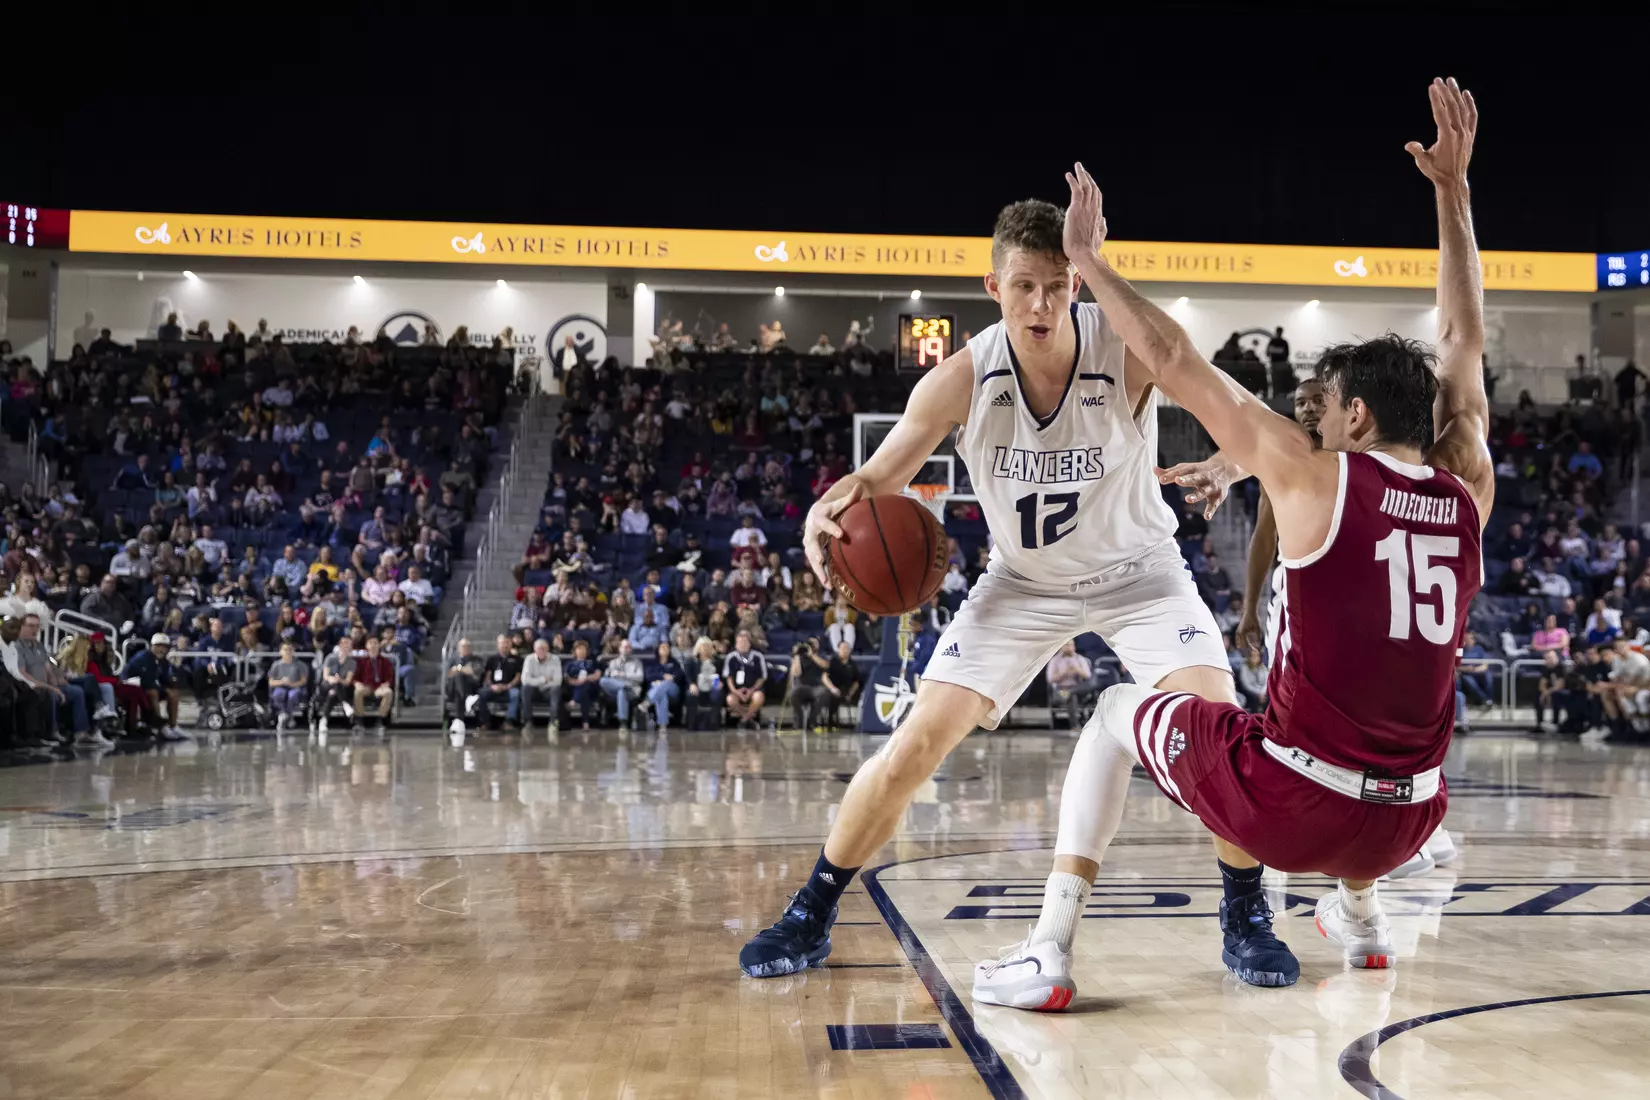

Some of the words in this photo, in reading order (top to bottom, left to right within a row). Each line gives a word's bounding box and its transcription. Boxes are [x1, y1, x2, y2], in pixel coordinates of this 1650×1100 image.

[176, 226, 255, 245] AYRES
[265, 229, 363, 249] HOTELS
[490, 236, 566, 255] AYRES
[576, 239, 669, 258] HOTELS
[793, 246, 867, 262] AYRES
[876, 247, 966, 265] HOTELS
[1102, 252, 1156, 270] YRES
[1166, 254, 1255, 273] HOTELS
[1370, 260, 1438, 278] AYRES
[1482, 264, 1533, 281] TELS
[911, 318, 950, 338] 2:27
[918, 337, 944, 366] 19
[1080, 395, 1105, 408] WAC
[992, 446, 1104, 484] LANCERS
[1015, 491, 1081, 550] 12
[1374, 528, 1460, 645] 15
